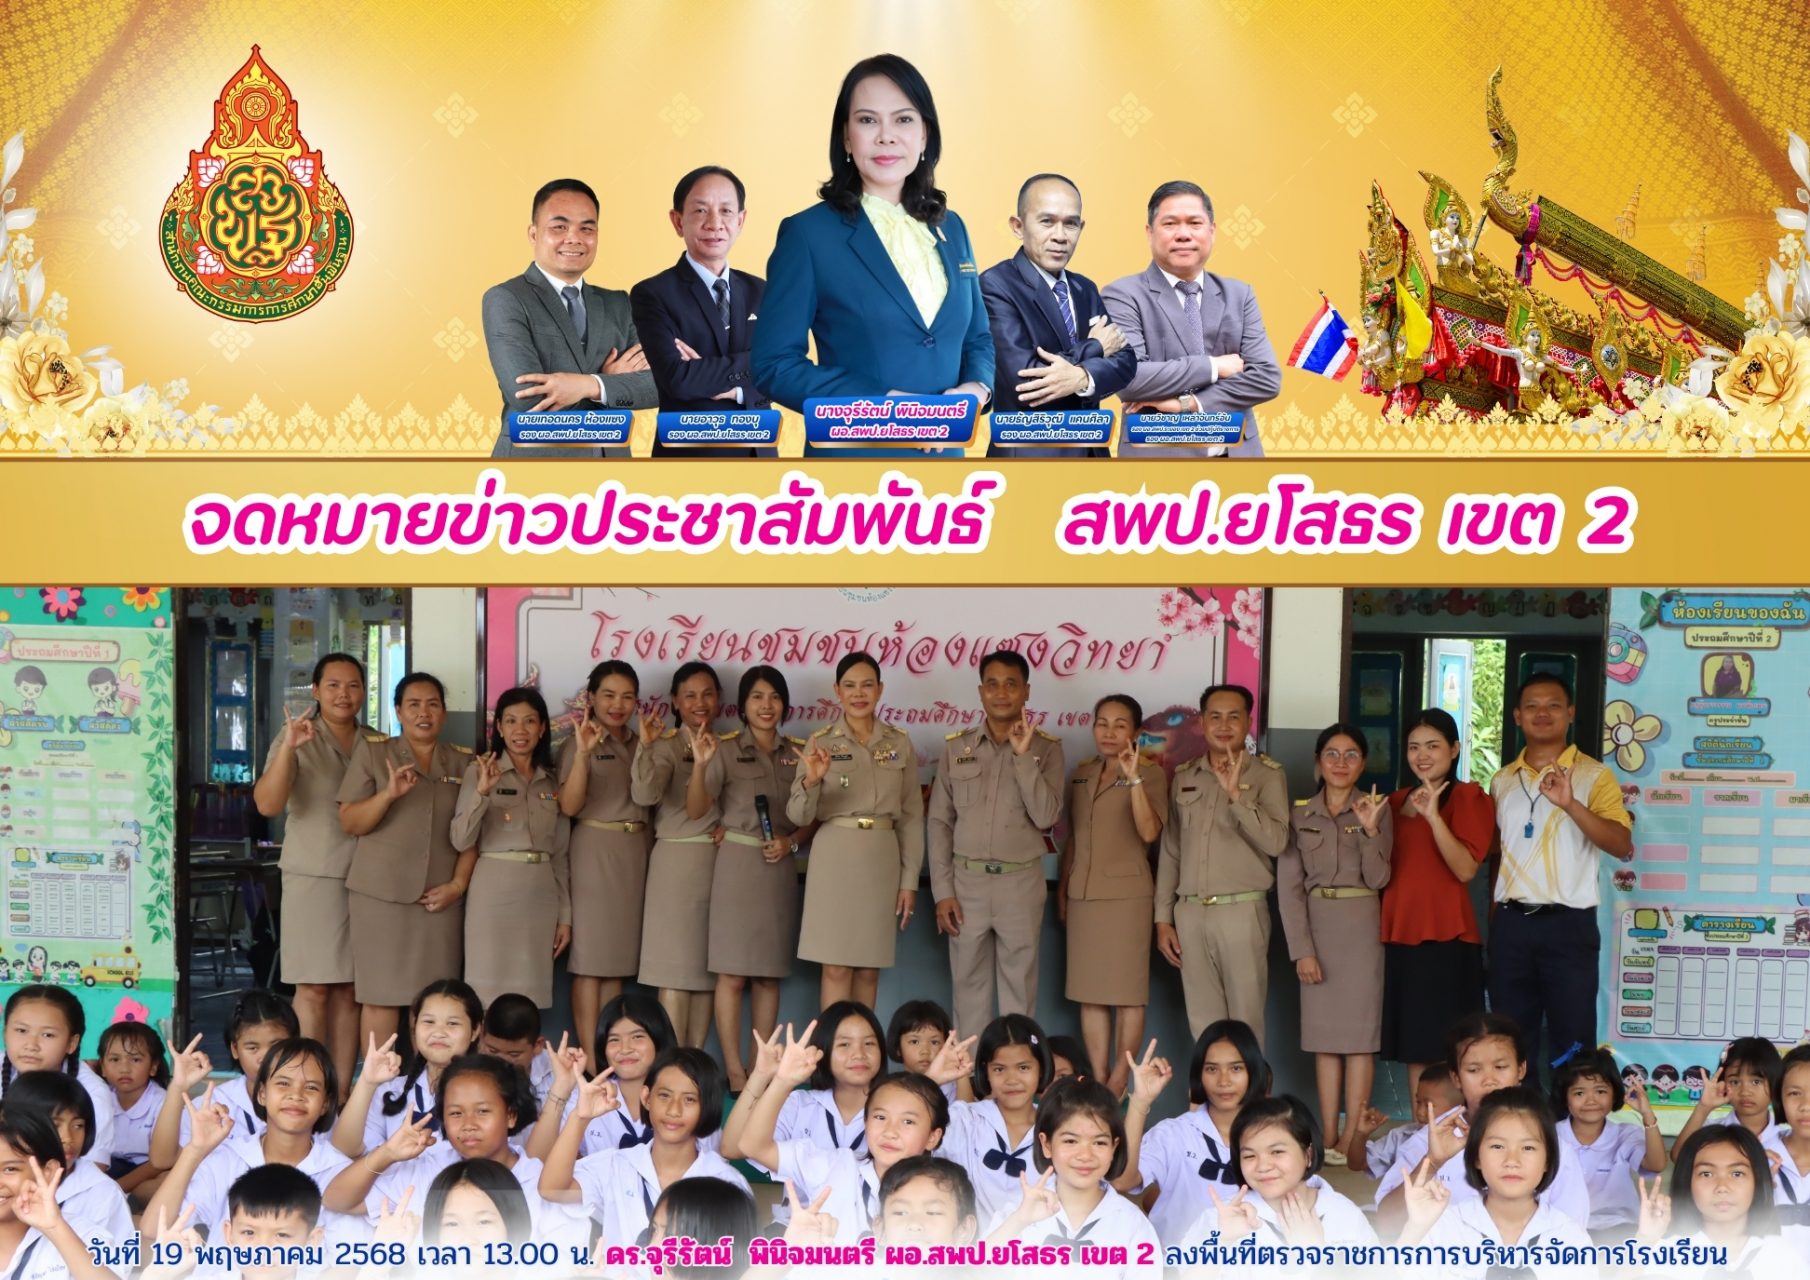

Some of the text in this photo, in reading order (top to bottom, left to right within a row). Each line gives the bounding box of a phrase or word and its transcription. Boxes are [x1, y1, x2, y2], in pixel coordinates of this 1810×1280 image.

[1672, 601, 1806, 620] ห้องเรียนของฉัน
[1692, 631, 1763, 643] ประถมศึกษาปีที่
[18, 643, 101, 658] ประถมศึกษาปีที่
